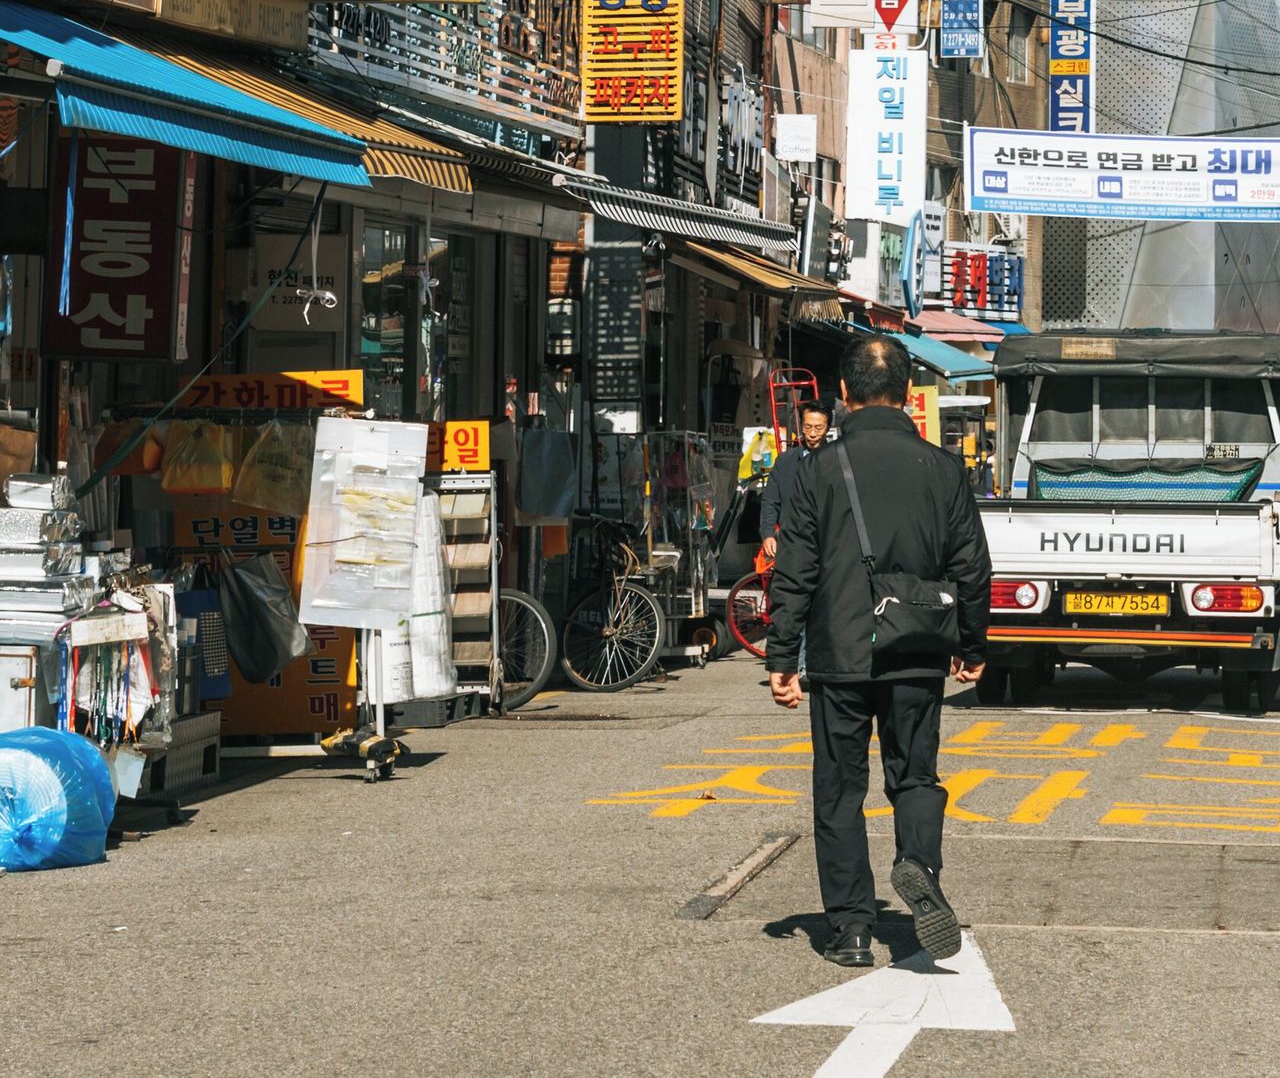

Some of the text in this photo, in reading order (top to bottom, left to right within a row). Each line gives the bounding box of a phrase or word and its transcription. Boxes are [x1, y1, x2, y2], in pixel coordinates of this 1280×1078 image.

[1055, 0, 1088, 60] 부광
[1054, 63, 1088, 73] 스크린
[594, 74, 670, 110] 패키지
[994, 146, 1089, 169] 신한으로
[1097, 151, 1144, 171] 연금
[1152, 153, 1198, 172] 받고
[1207, 148, 1272, 175] 최대
[66, 147, 158, 352] 부동산
[192, 515, 298, 546] 단열벽
[1040, 532, 1185, 554] HYUNDAI
[1118, 593, 1161, 612] 7554
